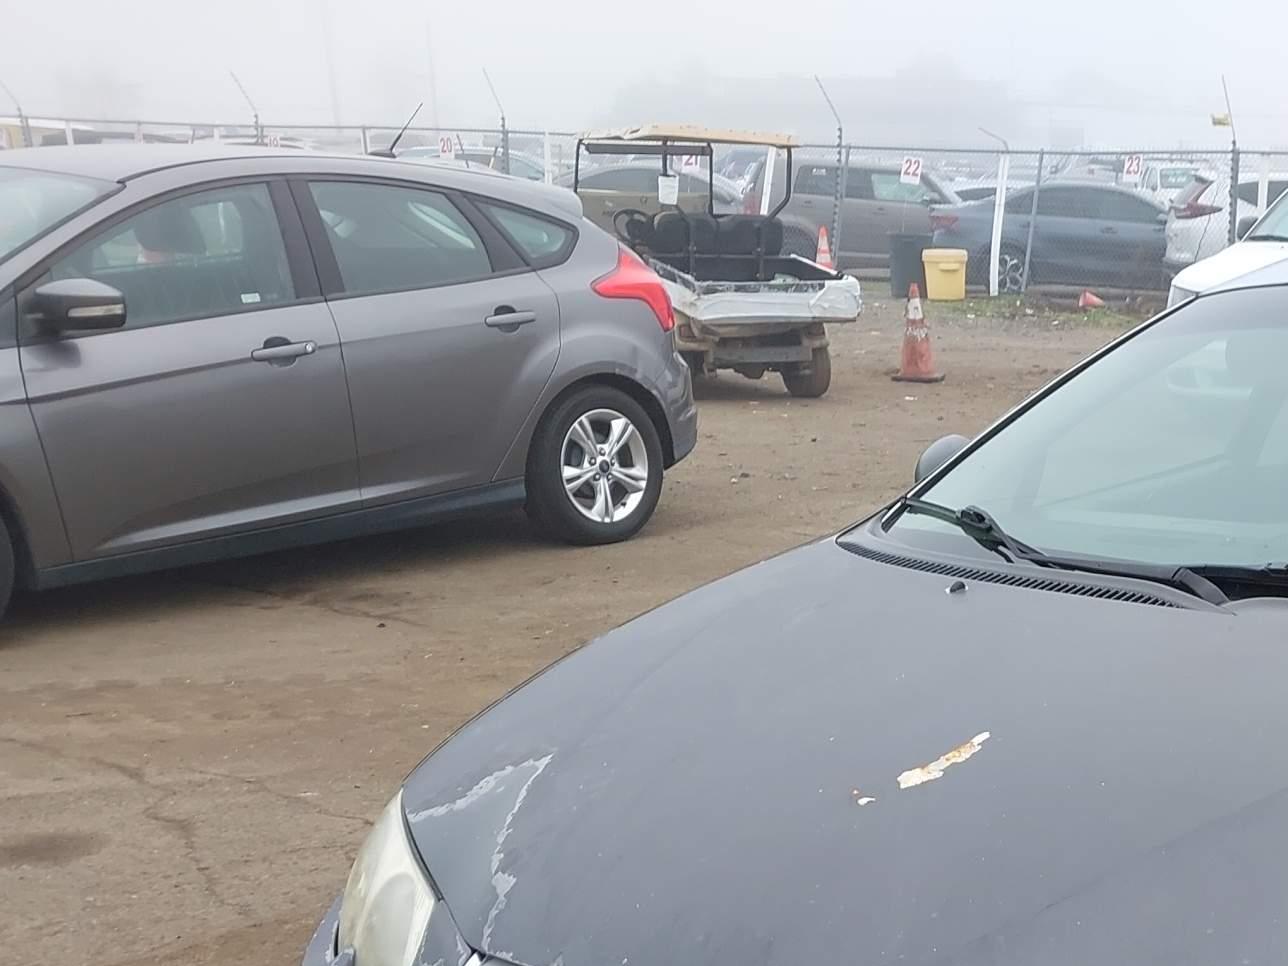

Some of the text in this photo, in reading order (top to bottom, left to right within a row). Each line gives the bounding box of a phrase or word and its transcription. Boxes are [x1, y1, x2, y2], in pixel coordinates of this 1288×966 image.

[439, 136, 453, 153] 20
[903, 158, 921, 176] 22
[1126, 156, 1141, 175] 23
